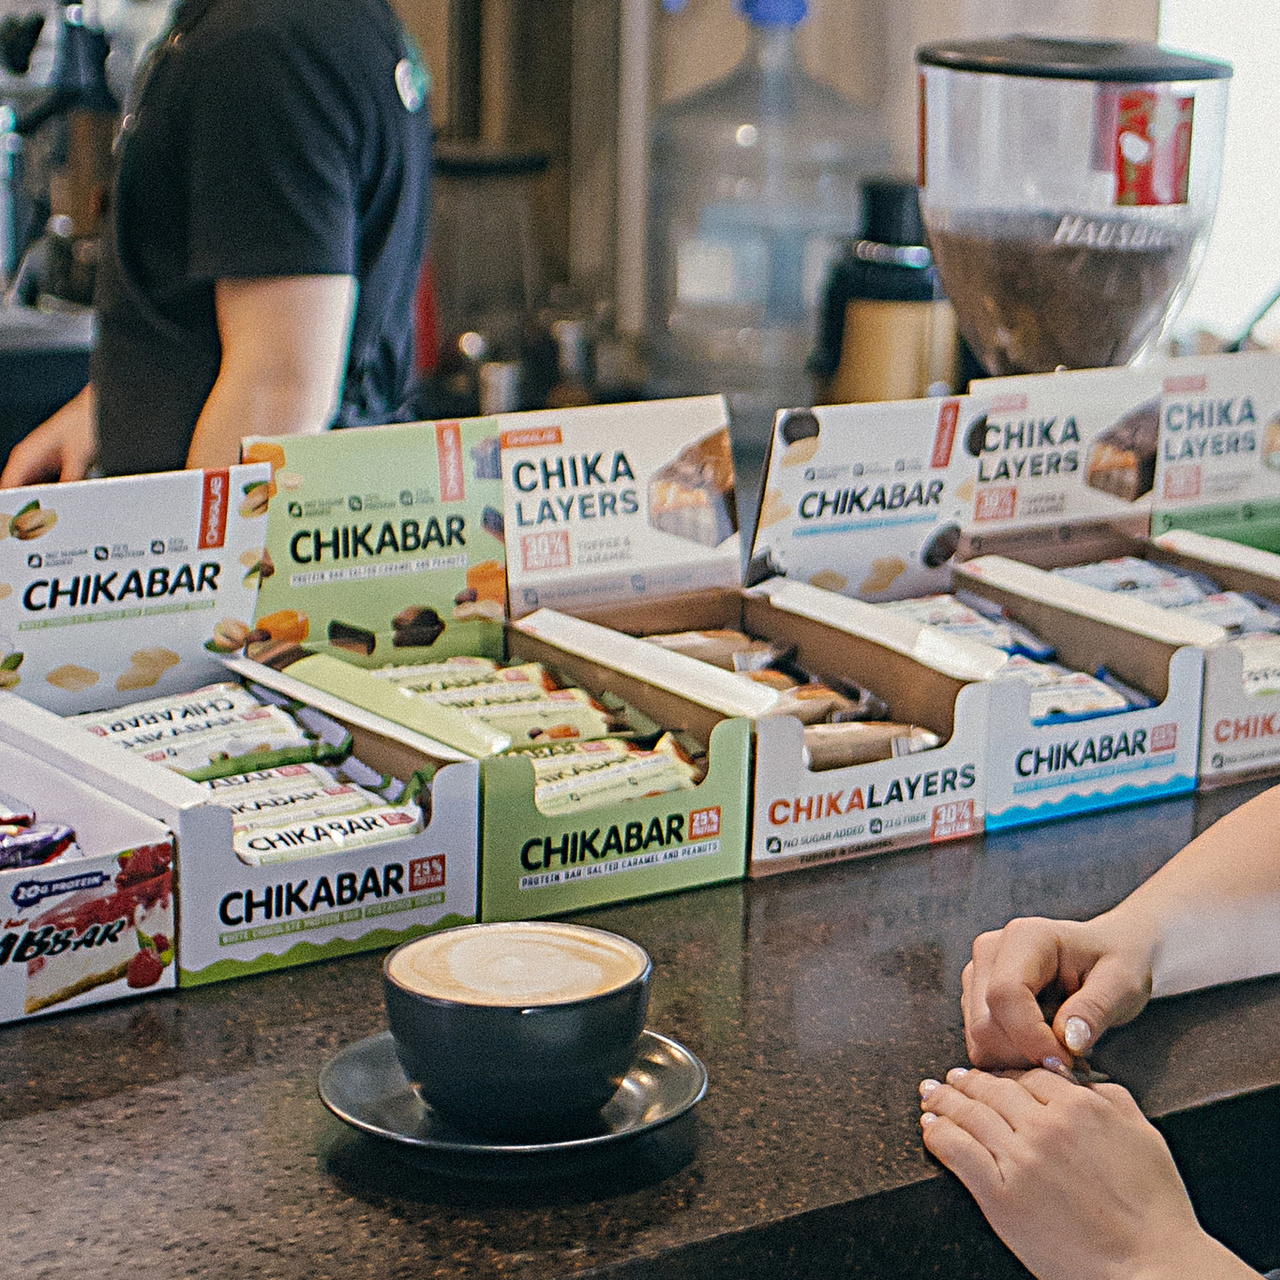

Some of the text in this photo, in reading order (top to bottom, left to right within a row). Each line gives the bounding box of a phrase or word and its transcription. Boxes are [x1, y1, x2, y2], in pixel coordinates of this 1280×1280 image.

[981, 414, 1080, 453] CHIKA
[1165, 397, 1256, 432] CHIKA
[1164, 429, 1256, 461] LAYERS
[511, 449, 635, 493] CHIKA
[977, 450, 1079, 483] LAYERS
[514, 488, 640, 528] LAYERS
[798, 478, 944, 520] CHIKABAR
[288, 513, 467, 565] CHIKABAR
[21, 561, 222, 611] CHIKABAR
[1014, 728, 1147, 777] CHIKABAR
[768, 763, 977, 826] CHIKALAYERS
[519, 812, 685, 871] CHIKABAR
[800, 831, 832, 846] SUGAR
[833, 825, 865, 840] ADDED
[51, 874, 102, 892] PROTEIN
[413, 856, 444, 877] 25%
[521, 842, 719, 888] PROTEIN BAR SALTED CARAMEL AND PEANUTS
[218, 861, 405, 926] CHIKABAR
